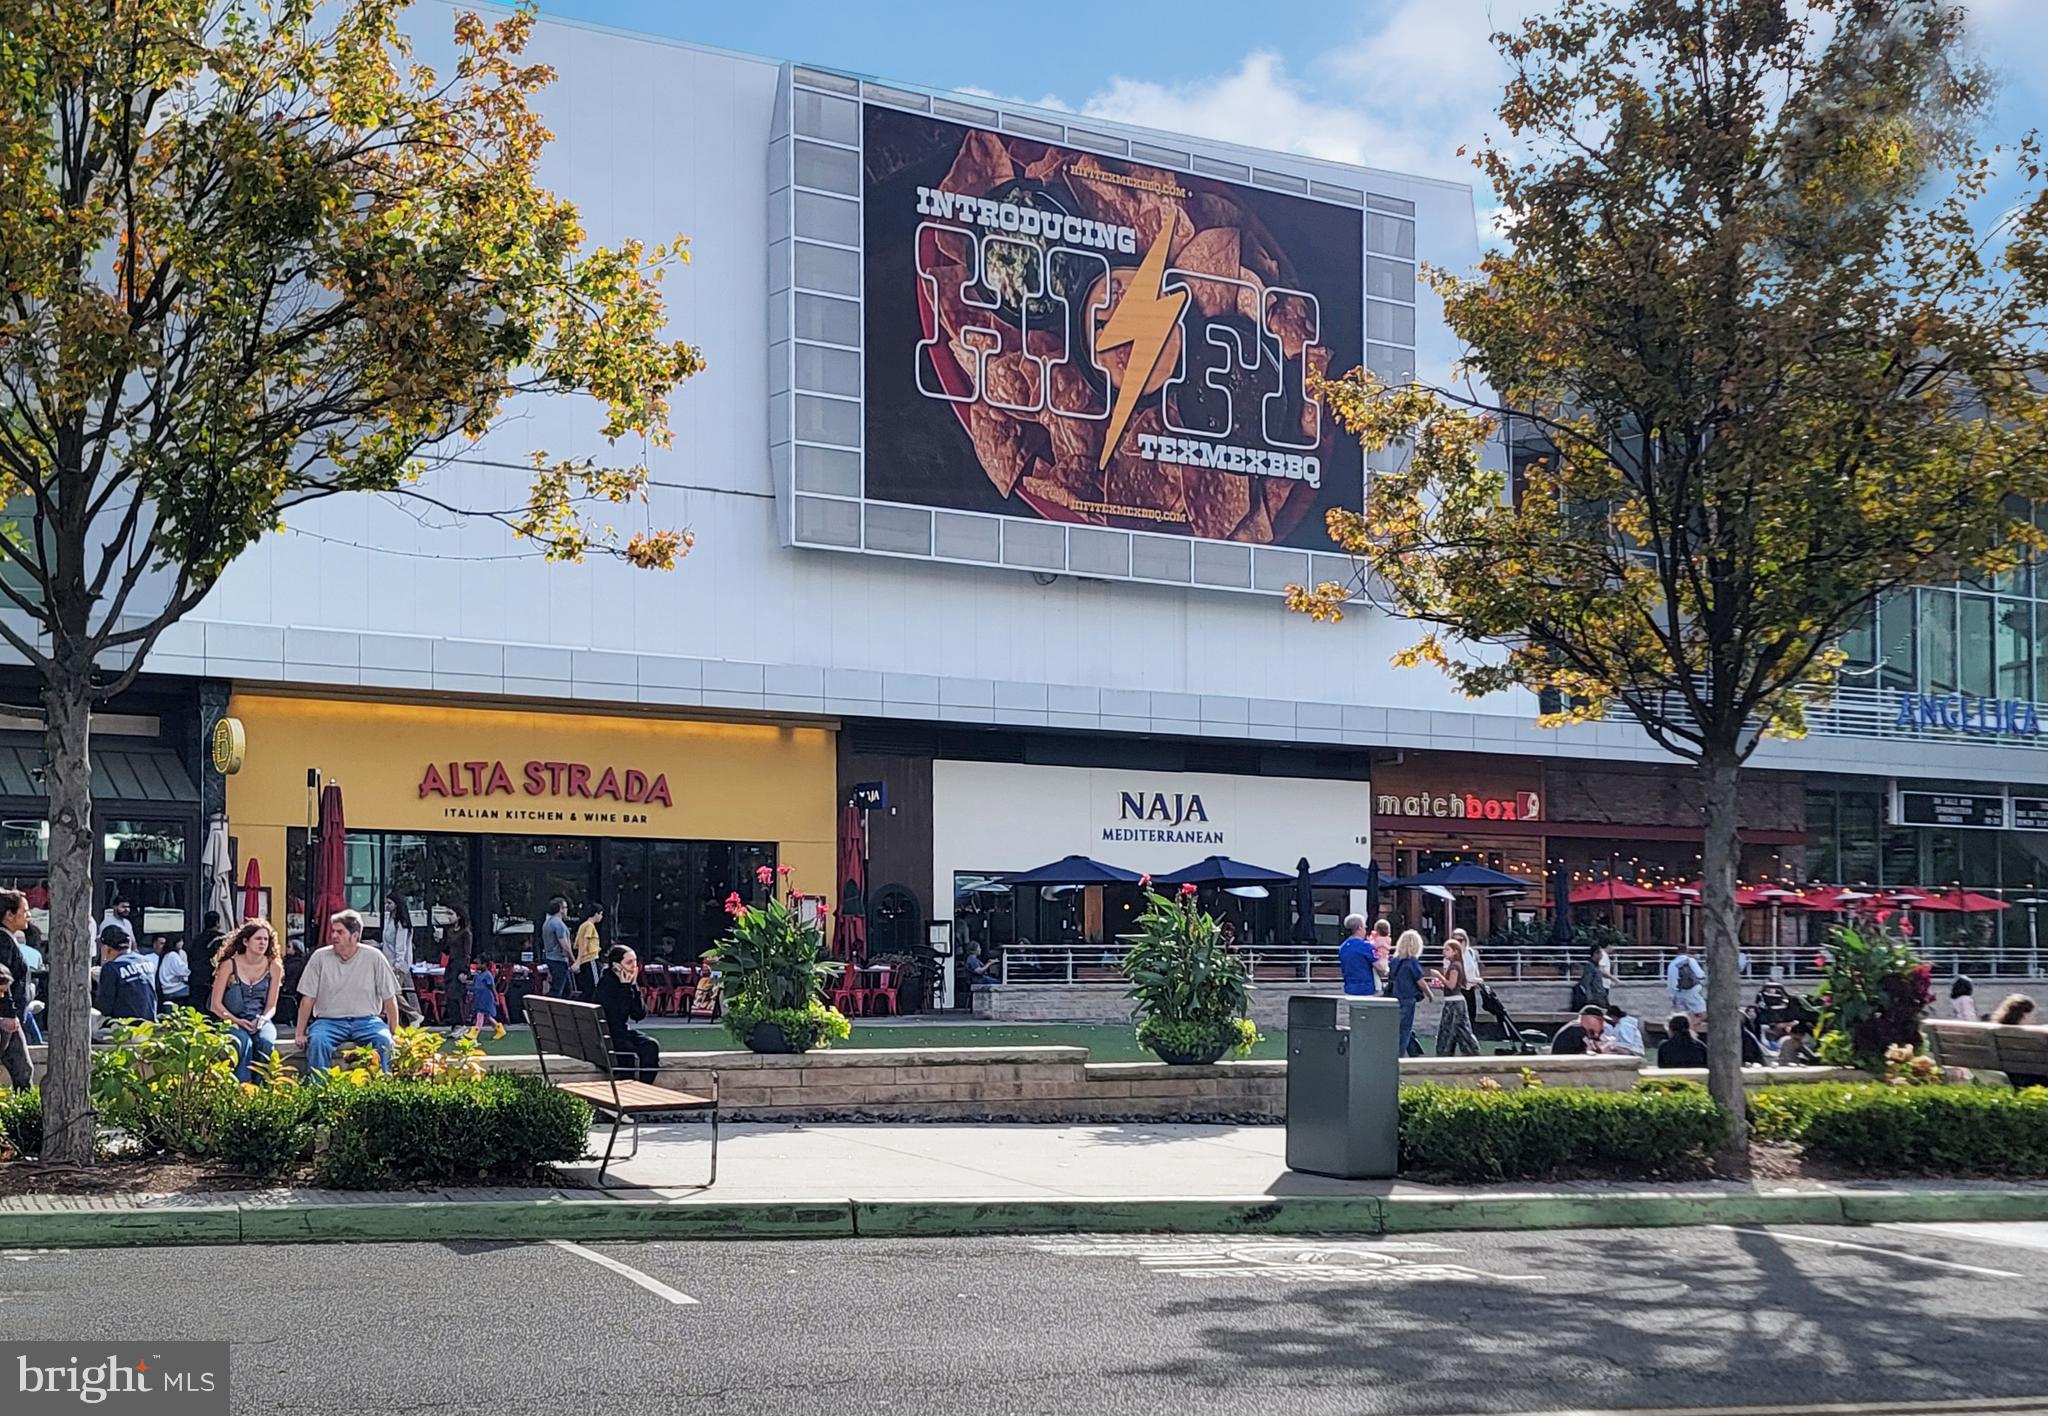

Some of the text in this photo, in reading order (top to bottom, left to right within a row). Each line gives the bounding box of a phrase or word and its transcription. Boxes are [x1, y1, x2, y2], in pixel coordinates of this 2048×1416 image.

[1070, 165, 1186, 199] HIFITEXMEXBBQ.COM
[916, 186, 1136, 254] INTRODUCING
[1138, 434, 1321, 489] TEXMEXBBQ
[1896, 693, 2040, 735] ANGELIKA
[419, 761, 673, 807] ALTA STRADA
[444, 807, 648, 824] ITALIAN KITCHEN & WINE BAR
[1119, 791, 1209, 827] NAJA
[1377, 791, 1517, 820] matchbox
[1102, 828, 1224, 844] MEDITERRANEAN
